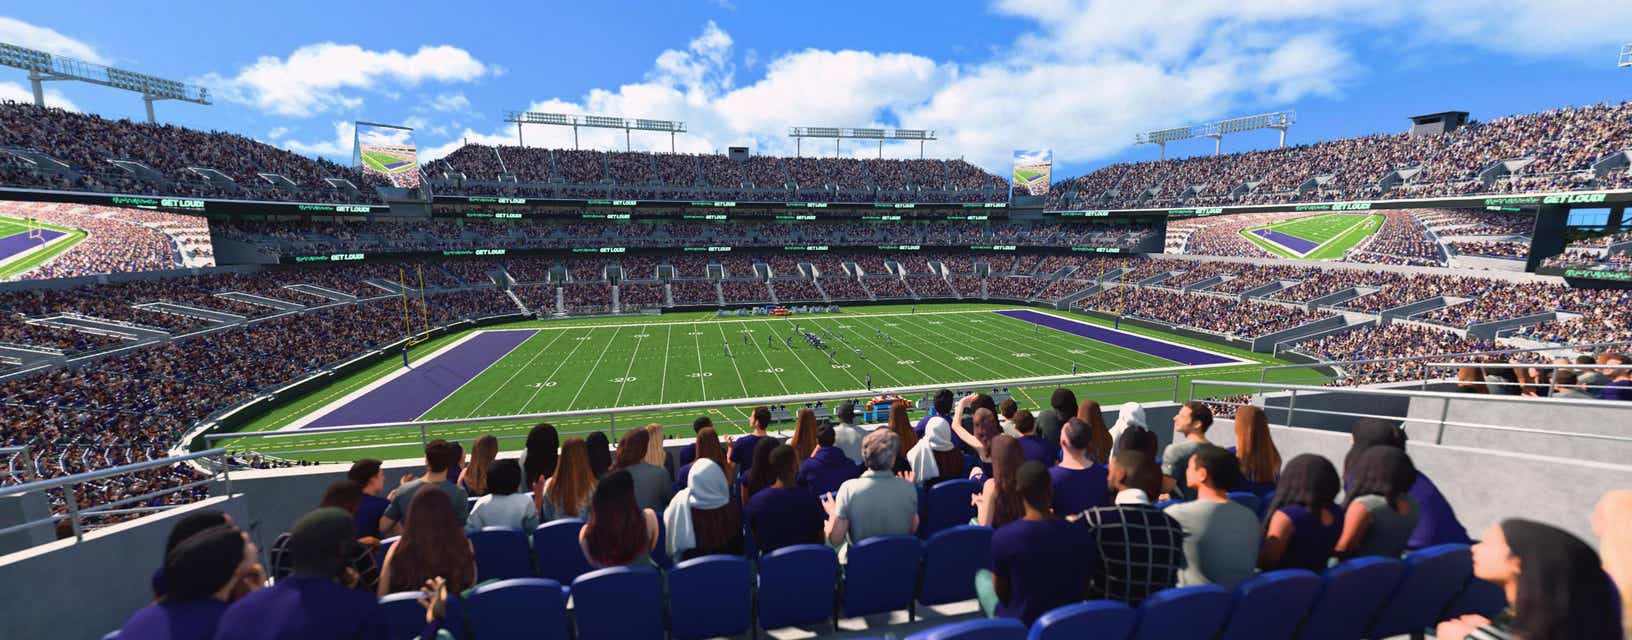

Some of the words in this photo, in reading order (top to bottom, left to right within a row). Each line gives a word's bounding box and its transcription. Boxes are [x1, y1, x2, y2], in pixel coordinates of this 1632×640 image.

[161, 199, 179, 207] GET
[180, 200, 205, 208] LOUD!
[1543, 194, 1570, 204] GET
